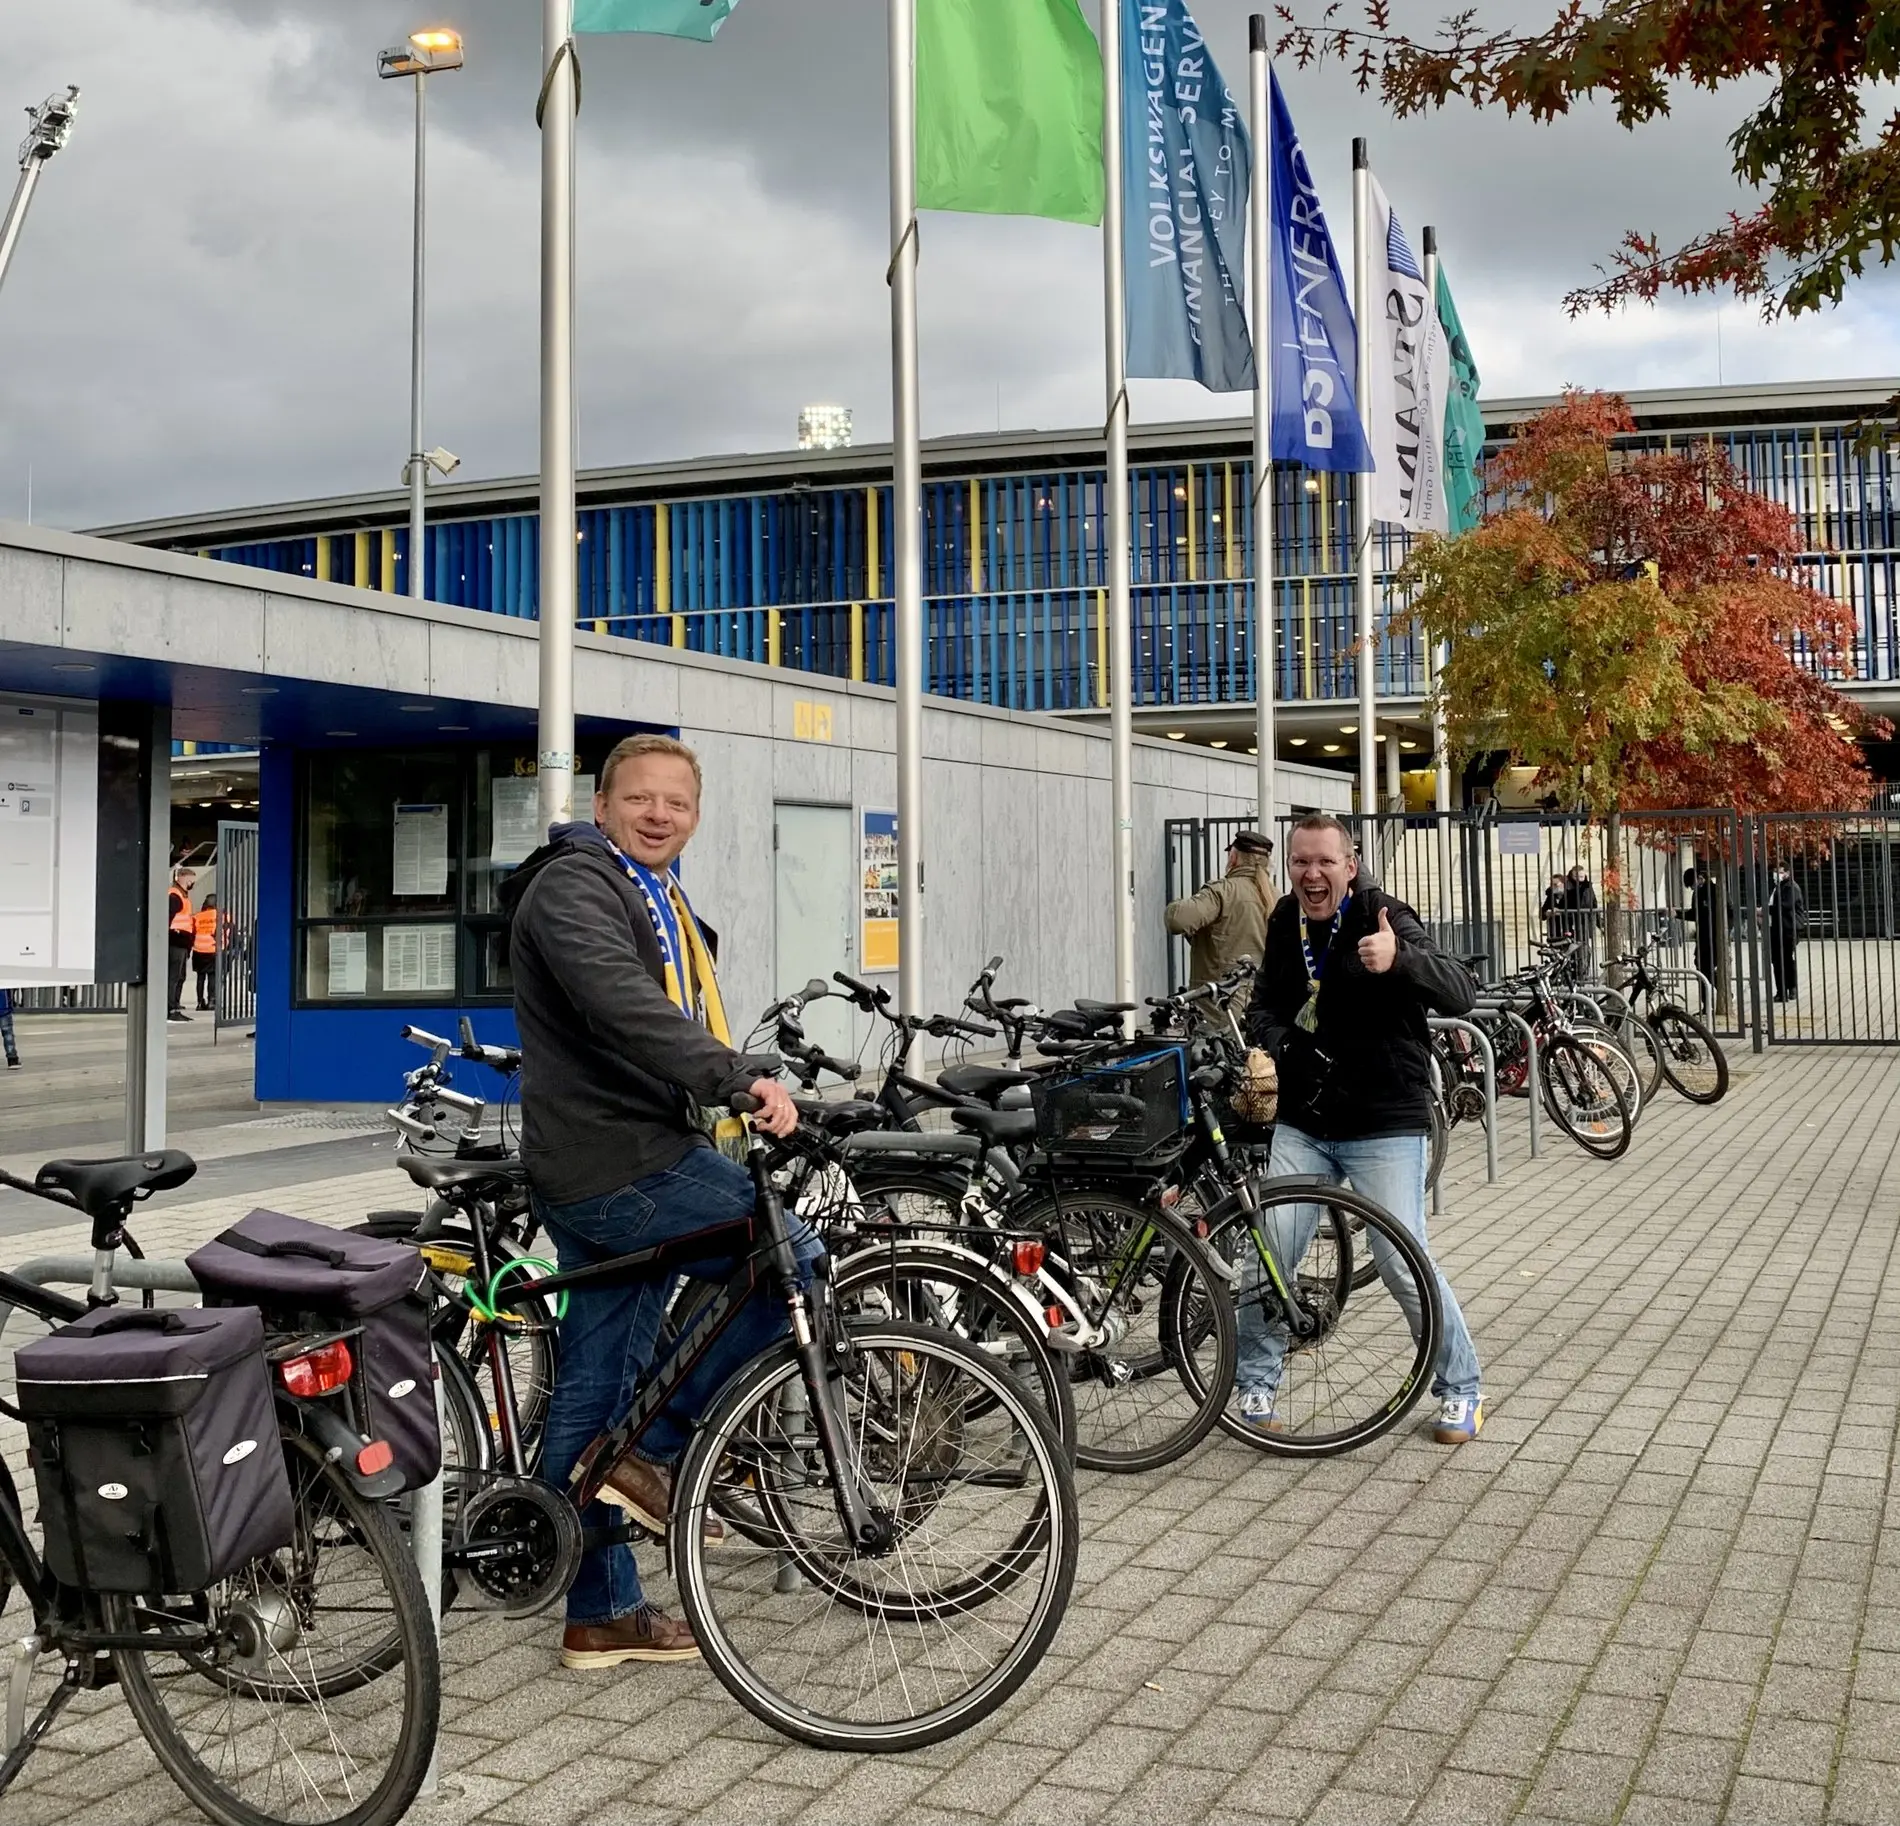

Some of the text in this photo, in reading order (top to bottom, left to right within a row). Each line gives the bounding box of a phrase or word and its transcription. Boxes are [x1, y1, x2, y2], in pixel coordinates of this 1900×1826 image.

[1140, 6, 1177, 268] VOLKSWAGEN
[1215, 145, 1231, 177] TO
[1178, 139, 1204, 345] FINANCIAL
[1208, 189, 1226, 238] EY
